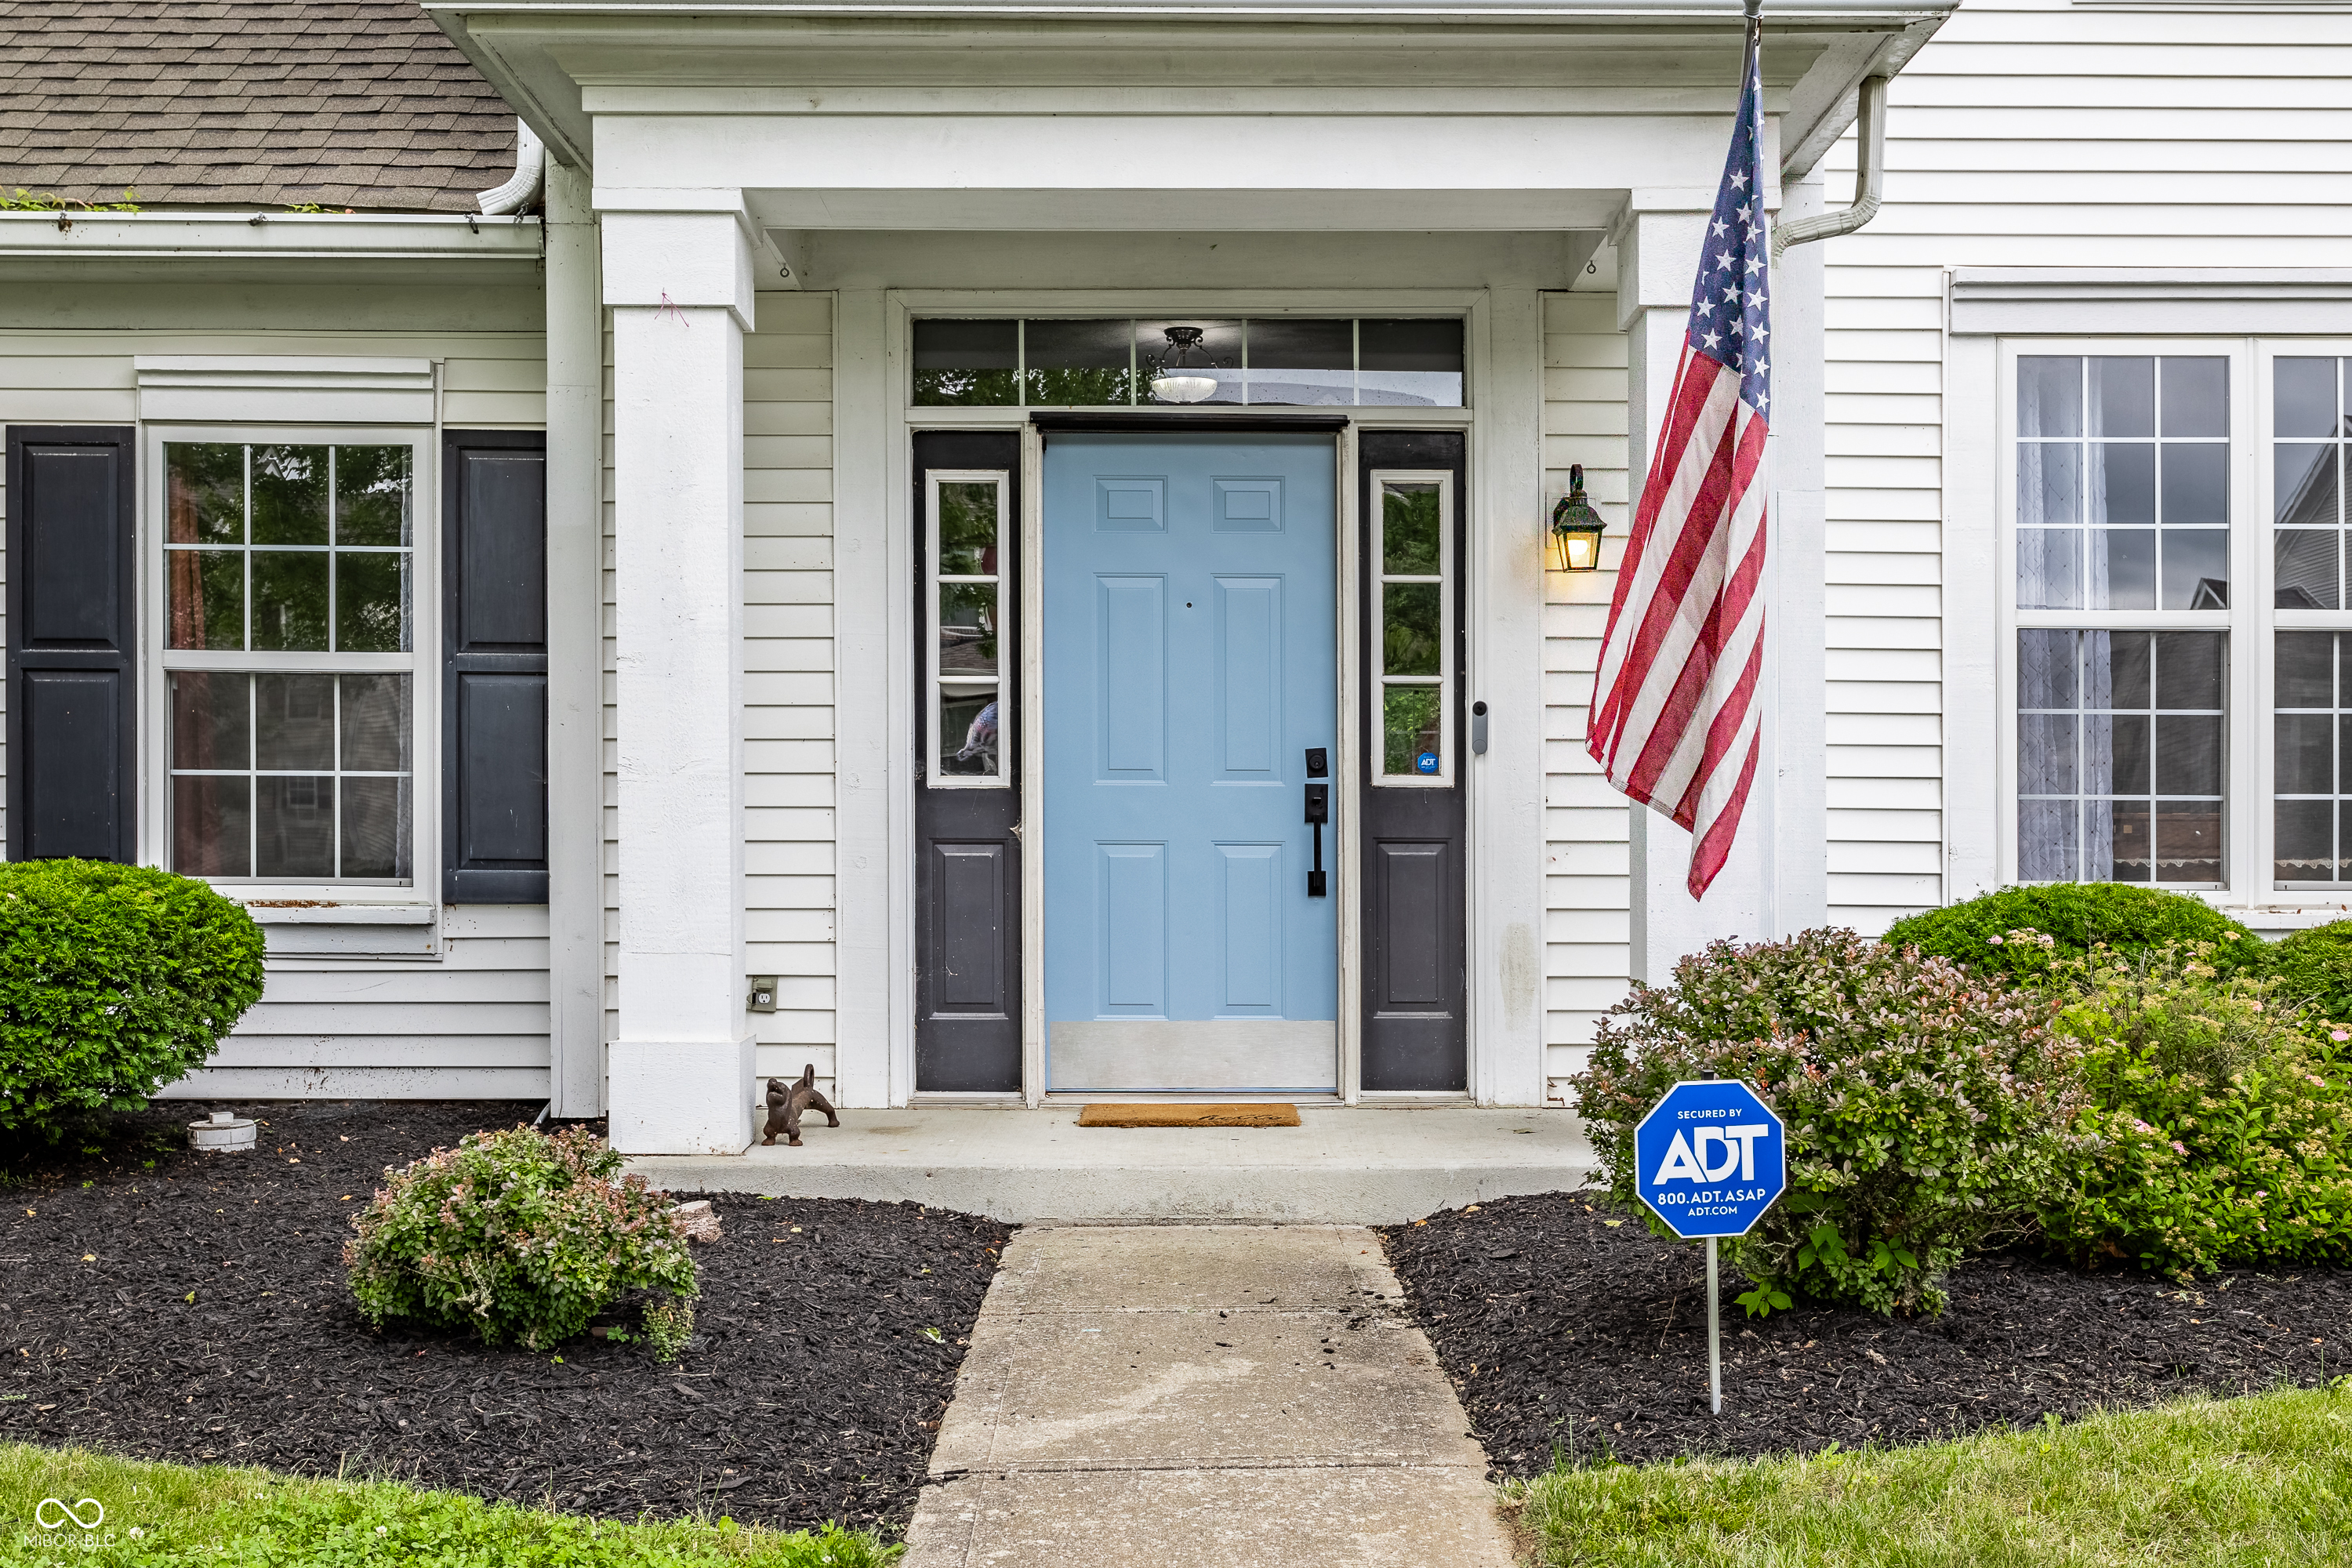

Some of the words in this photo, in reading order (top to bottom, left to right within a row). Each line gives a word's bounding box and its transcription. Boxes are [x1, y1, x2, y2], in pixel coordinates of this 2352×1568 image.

[1677, 1109, 1726, 1120] SECURED
[1729, 1108, 1743, 1117] BY
[1652, 1123, 1769, 1185] ADT
[1657, 1188, 1766, 1206] 800.ADT.ASAP
[1687, 1206, 1738, 1217] ADT.COM
